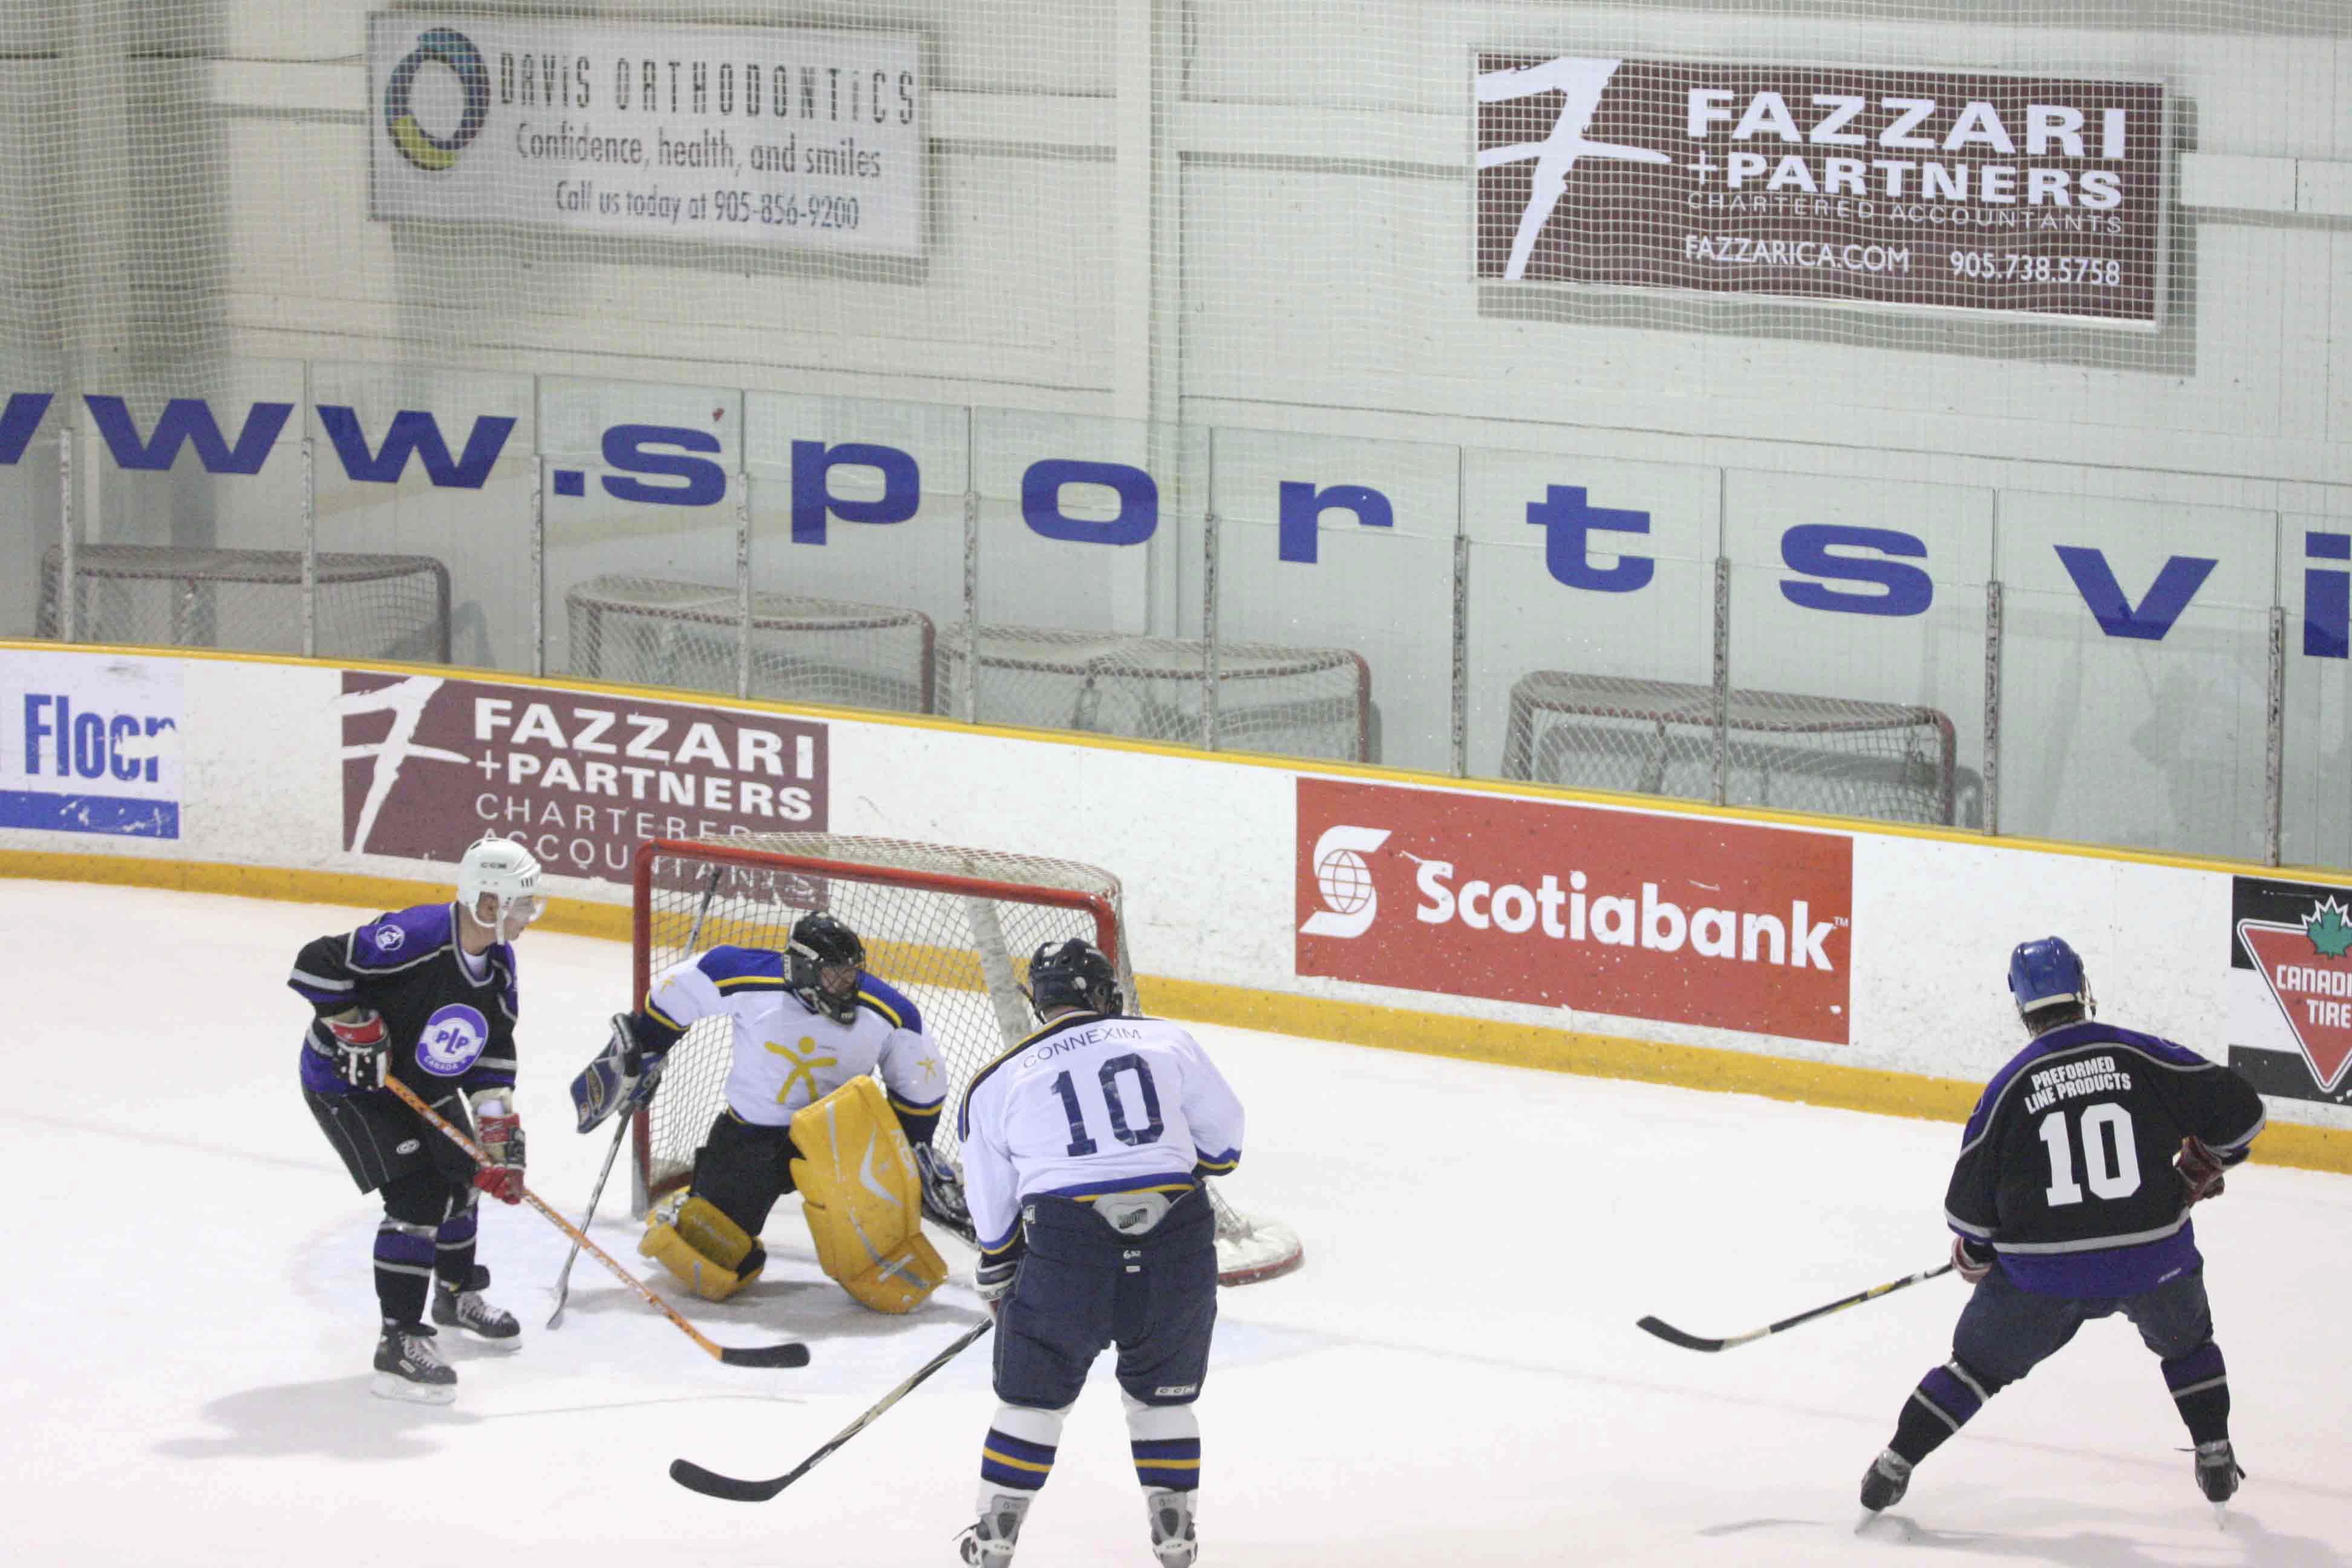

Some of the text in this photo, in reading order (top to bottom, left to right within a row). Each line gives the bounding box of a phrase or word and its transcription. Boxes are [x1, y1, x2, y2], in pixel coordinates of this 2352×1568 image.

[1686, 87, 2125, 160] FAZZARI
[516, 121, 881, 178] Confidence, health, and smiles
[556, 180, 860, 230] Call us today at 905-856-9200
[1687, 192, 2123, 234] CHARTERED ACCOUNTANTS
[1685, 235, 2121, 286] FAZZARICA.COM 905.738.5758
[474, 696, 814, 780] FAZZARI
[1416, 859, 1834, 972] Scotiabank
[2306, 998, 2351, 1029] TIRE
[1023, 1027, 1142, 1068] CONNEXIM
[2024, 1072, 2132, 1115] LINE PRODUCTS
[2030, 1056, 2116, 1091] PREFORMED
[1050, 1052, 1165, 1157] 10
[2039, 1102, 2141, 1207] 10
